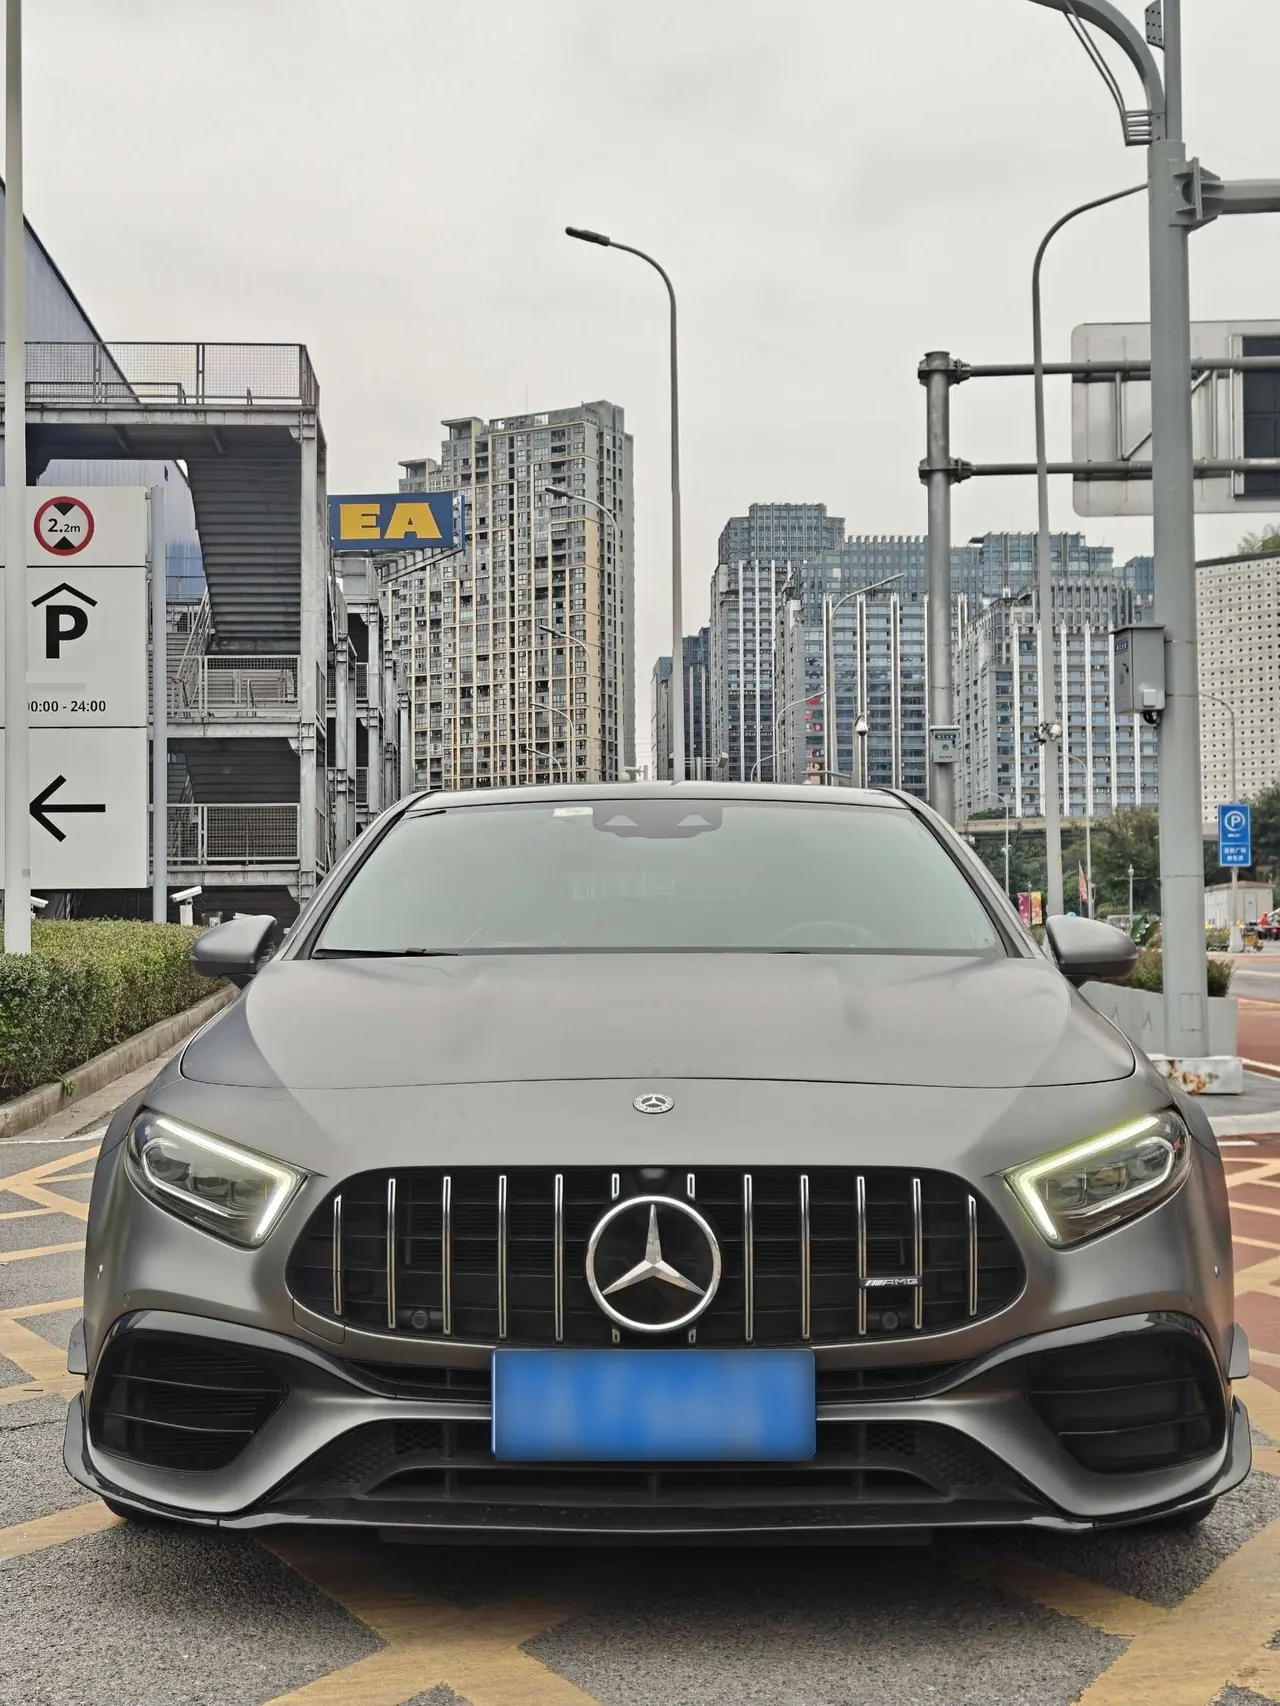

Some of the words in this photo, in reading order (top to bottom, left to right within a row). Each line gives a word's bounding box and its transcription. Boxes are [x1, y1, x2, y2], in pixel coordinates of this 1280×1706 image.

[48, 518, 81, 533] 2.2m
[46, 604, 88, 659] P
[28, 701, 59, 712] 0:00
[70, 701, 106, 712] 24:00
[1231, 815, 1241, 827] P
[882, 1278, 918, 1286] AMG
